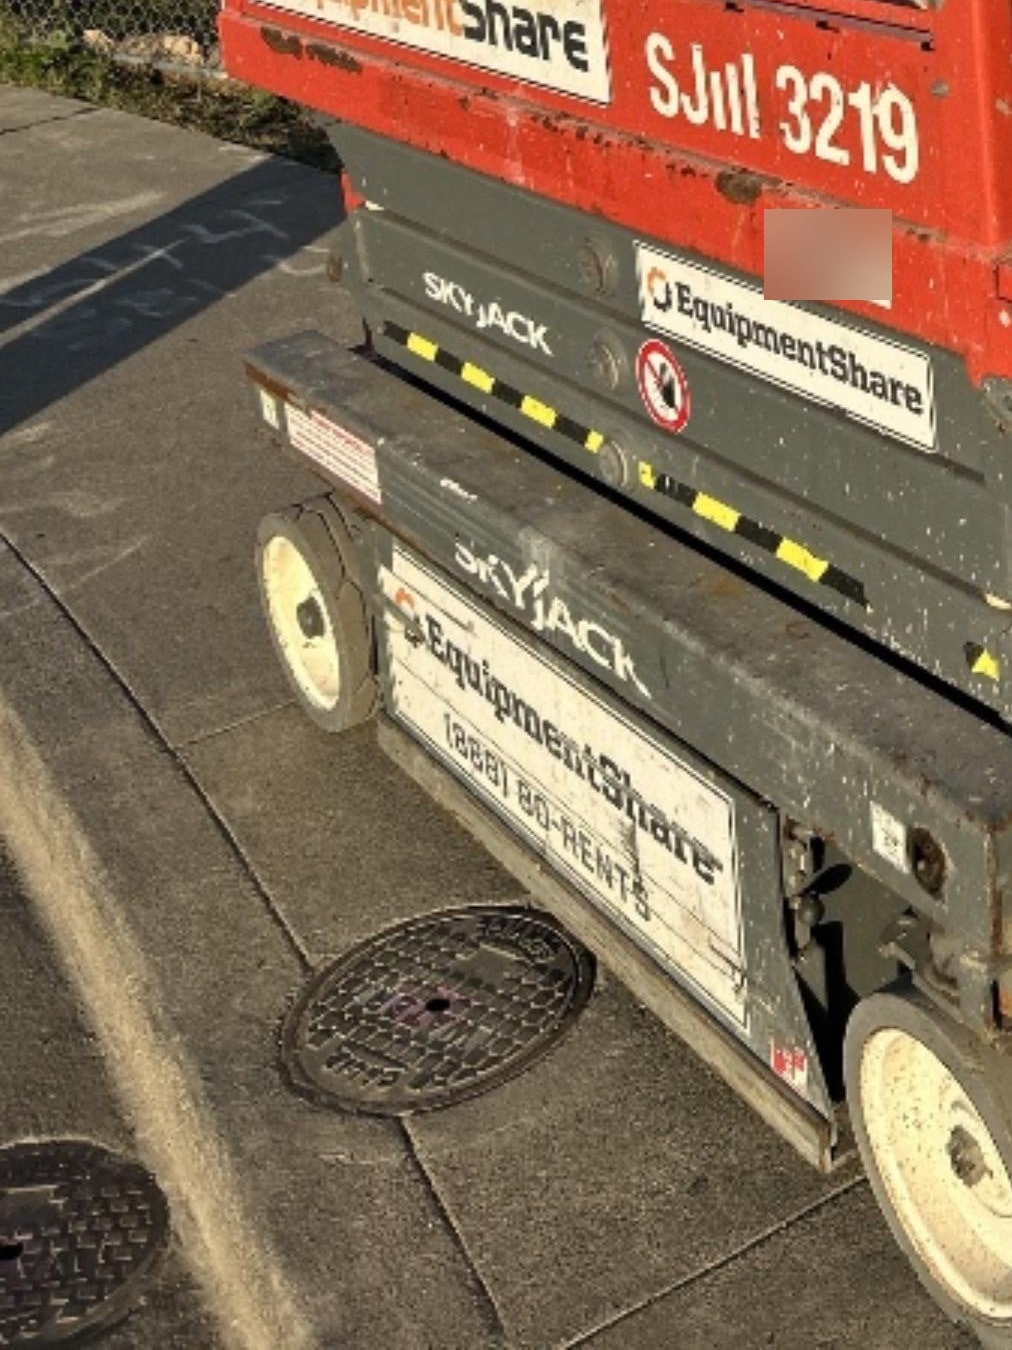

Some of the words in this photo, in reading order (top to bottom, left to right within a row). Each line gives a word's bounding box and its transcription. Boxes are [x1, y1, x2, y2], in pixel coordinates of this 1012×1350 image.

[775, 64, 919, 184] 3219
[676, 281, 924, 415] EquipmentShare
[425, 613, 724, 887] EquipmentShare
